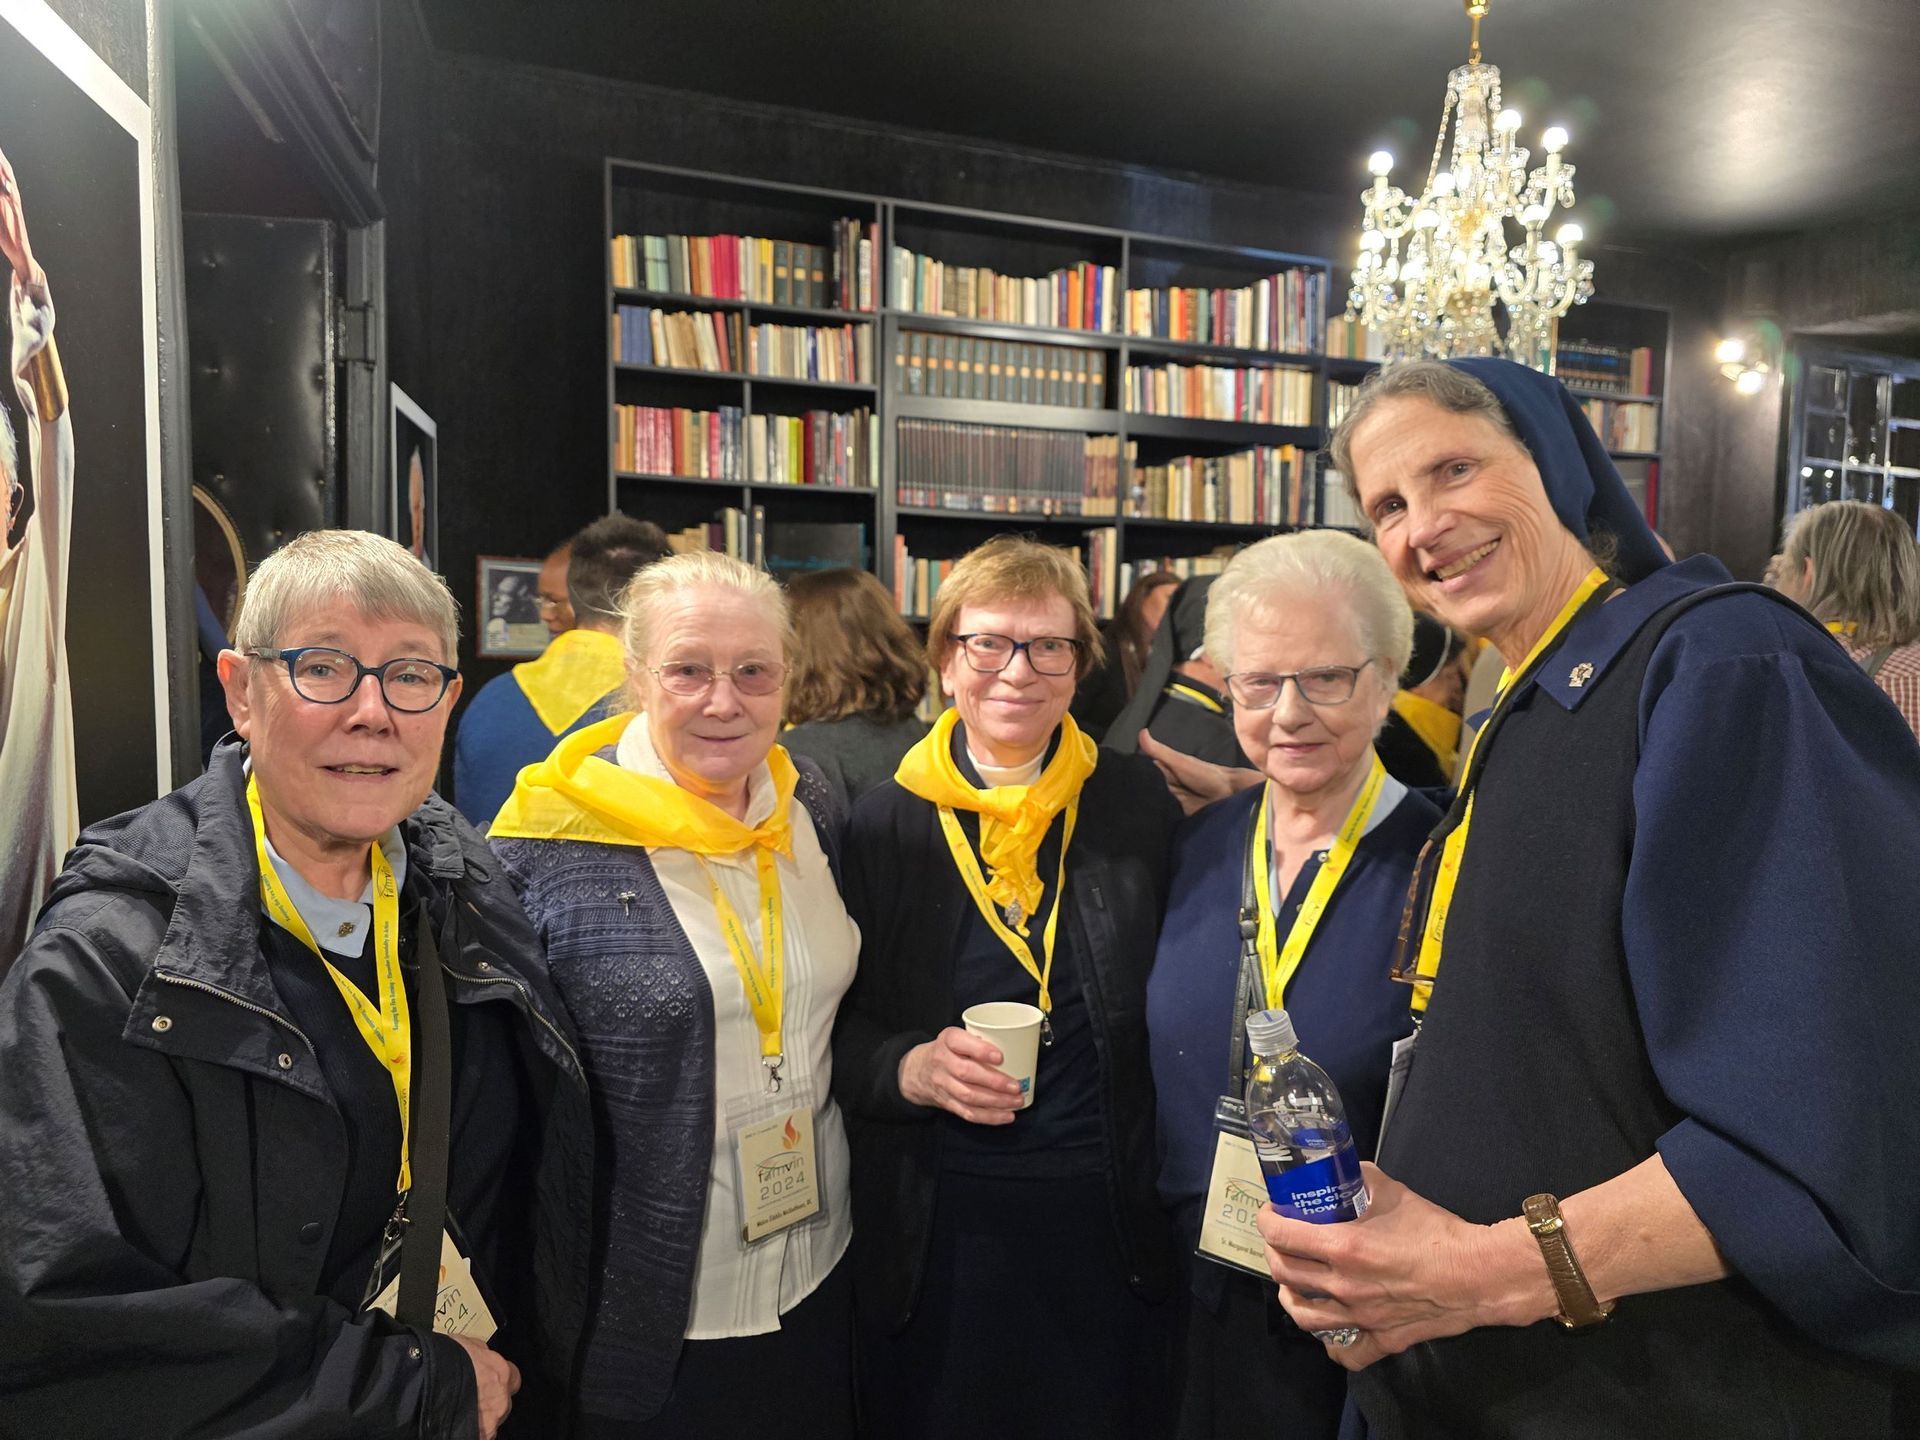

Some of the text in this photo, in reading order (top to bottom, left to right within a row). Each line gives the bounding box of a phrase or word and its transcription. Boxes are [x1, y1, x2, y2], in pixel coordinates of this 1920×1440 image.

[758, 1155, 805, 1184] famvin
[760, 1170, 805, 1201] 2024
[1224, 1184, 1266, 1209] famv
[1222, 1203, 1258, 1228] 202
[1293, 1198, 1323, 1209] the
[1302, 1203, 1338, 1216] how
[434, 1288, 462, 1322] vin
[444, 1303, 469, 1334] 24
